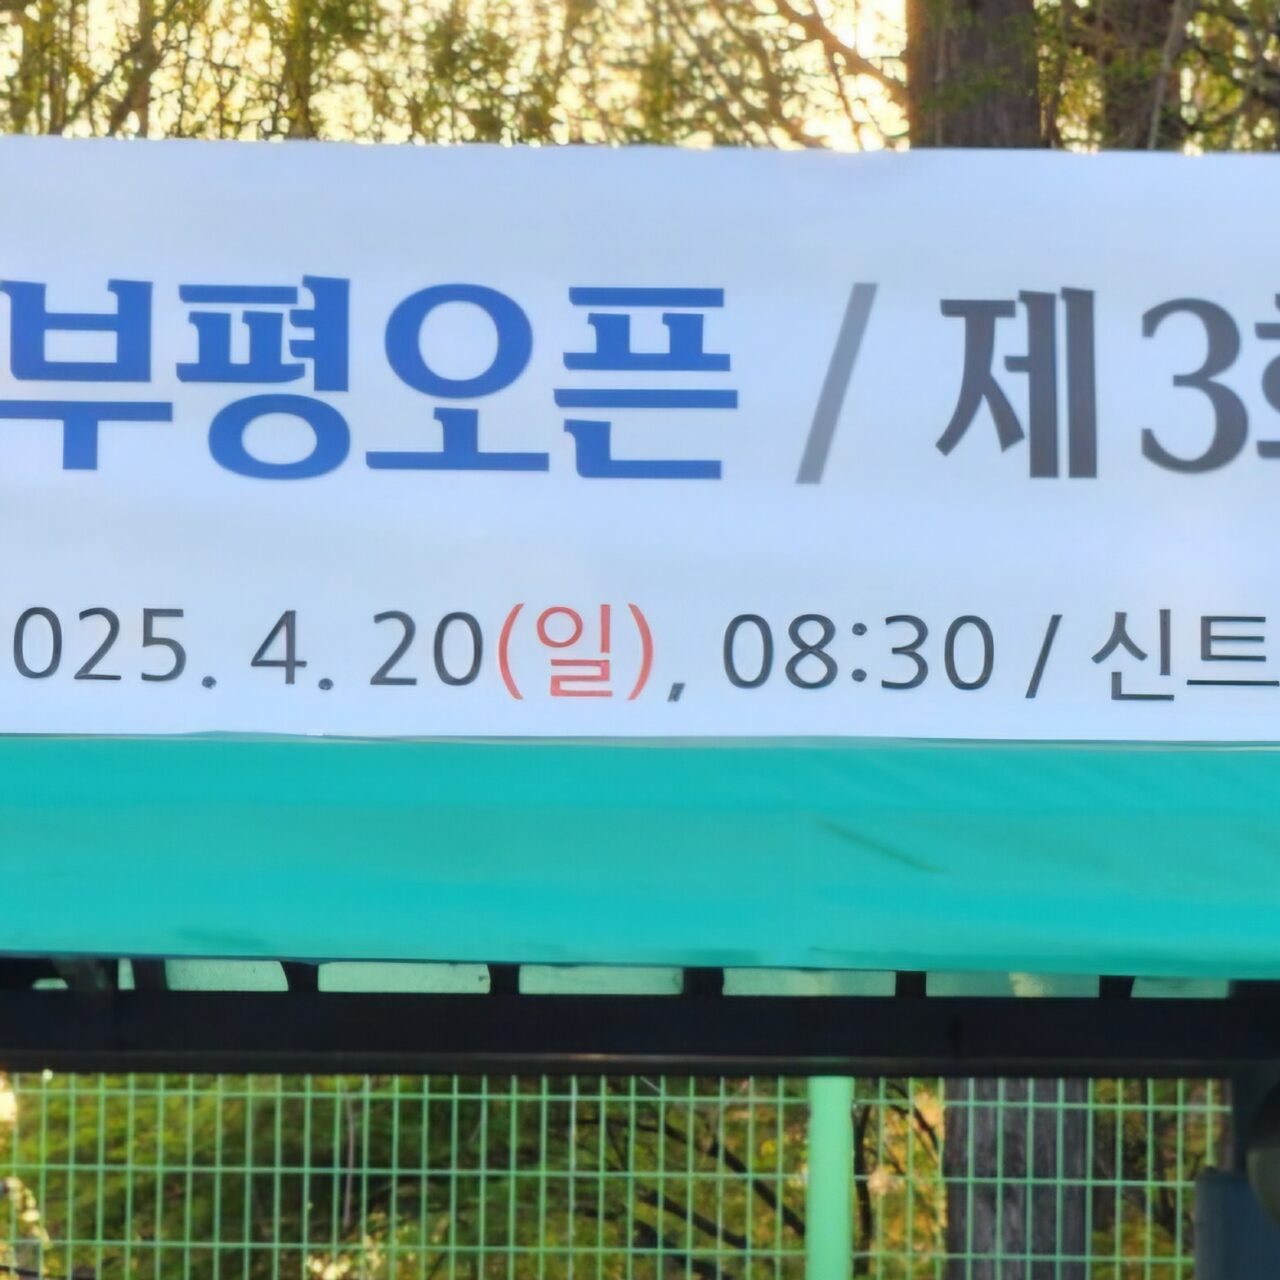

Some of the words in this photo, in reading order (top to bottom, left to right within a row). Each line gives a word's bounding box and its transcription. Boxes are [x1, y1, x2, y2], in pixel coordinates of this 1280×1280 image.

[0, 274, 739, 481] 부평오픈
[249, 609, 334, 690] 4.
[369, 603, 686, 703] 20(일),
[721, 613, 995, 691] 08:30
